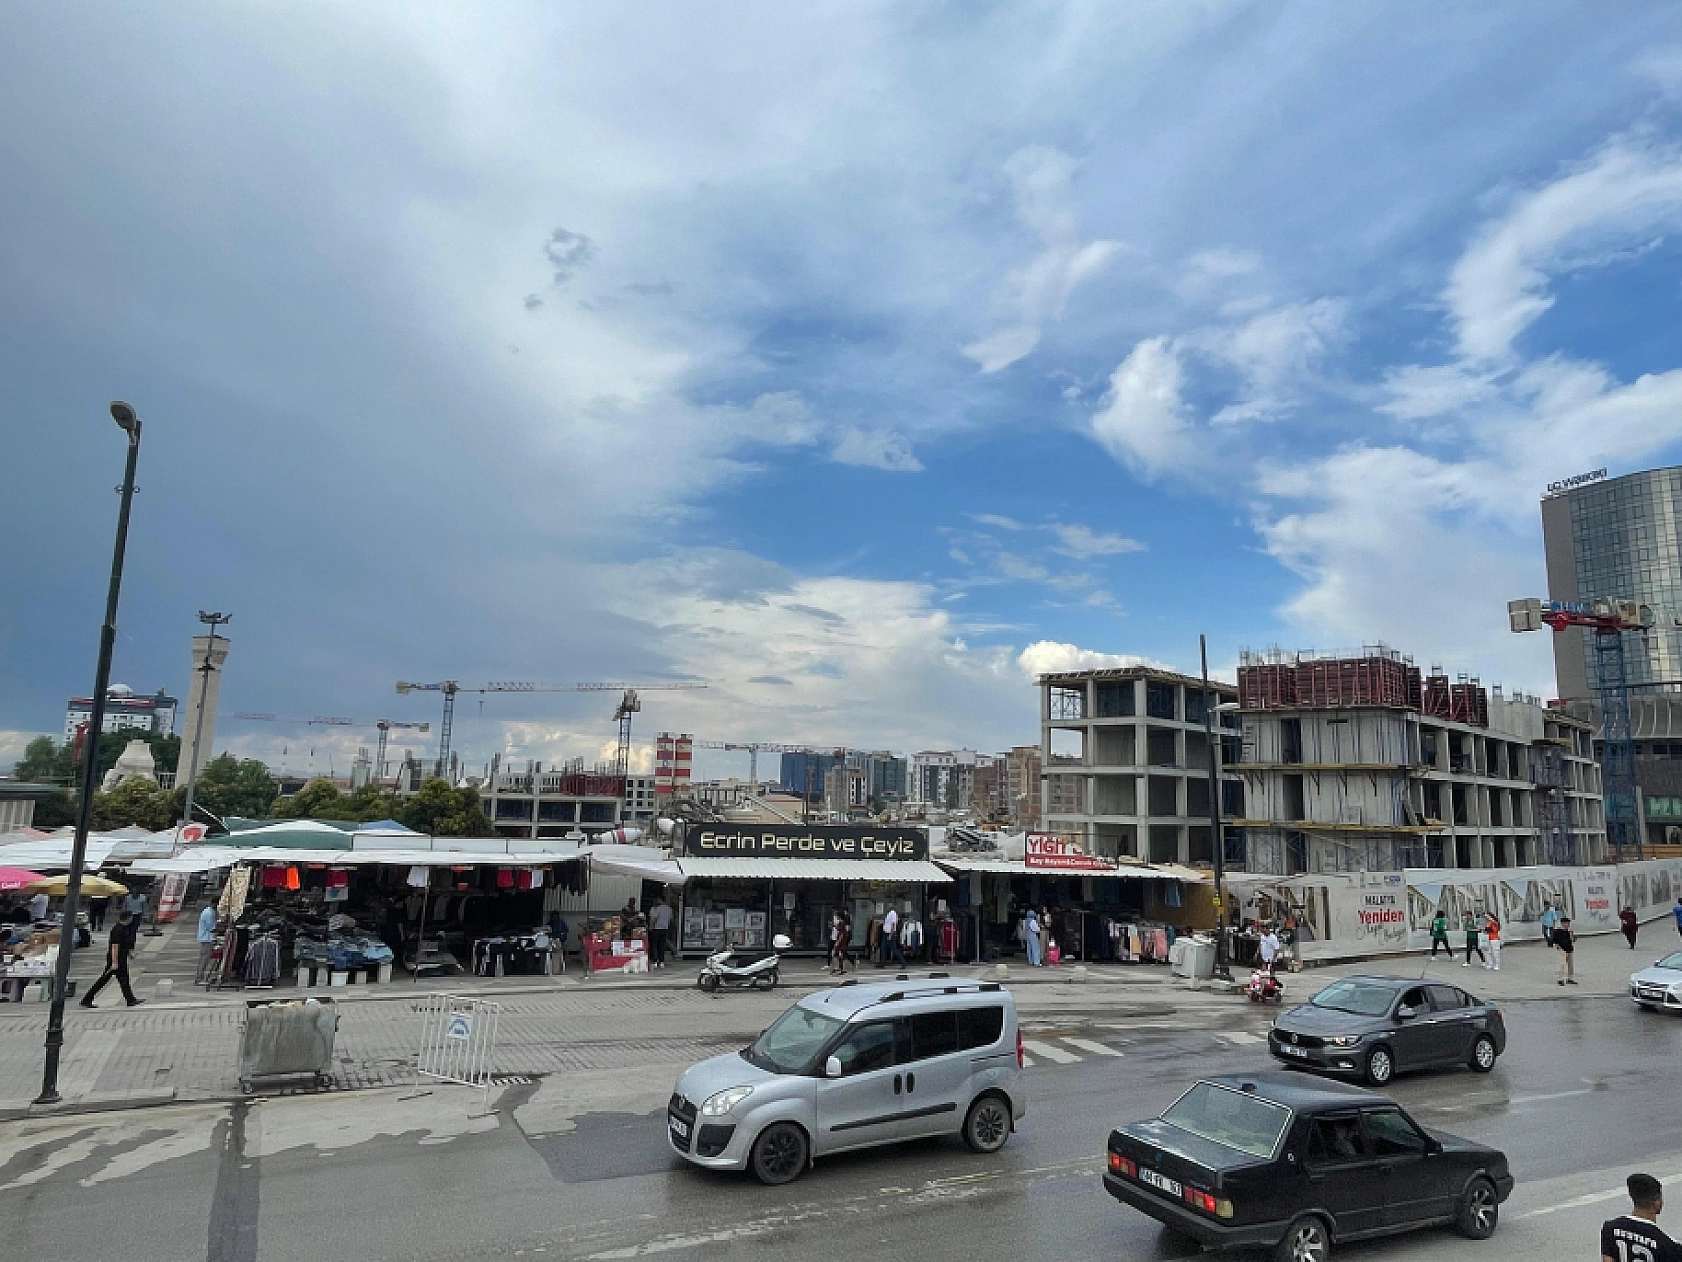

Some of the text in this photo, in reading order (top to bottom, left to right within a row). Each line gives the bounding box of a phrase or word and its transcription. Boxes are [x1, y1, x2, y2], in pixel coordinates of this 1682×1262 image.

[700, 831, 914, 857] Ecrin Perde ve Çeyiz
[1357, 908, 1405, 924] Yeniden
